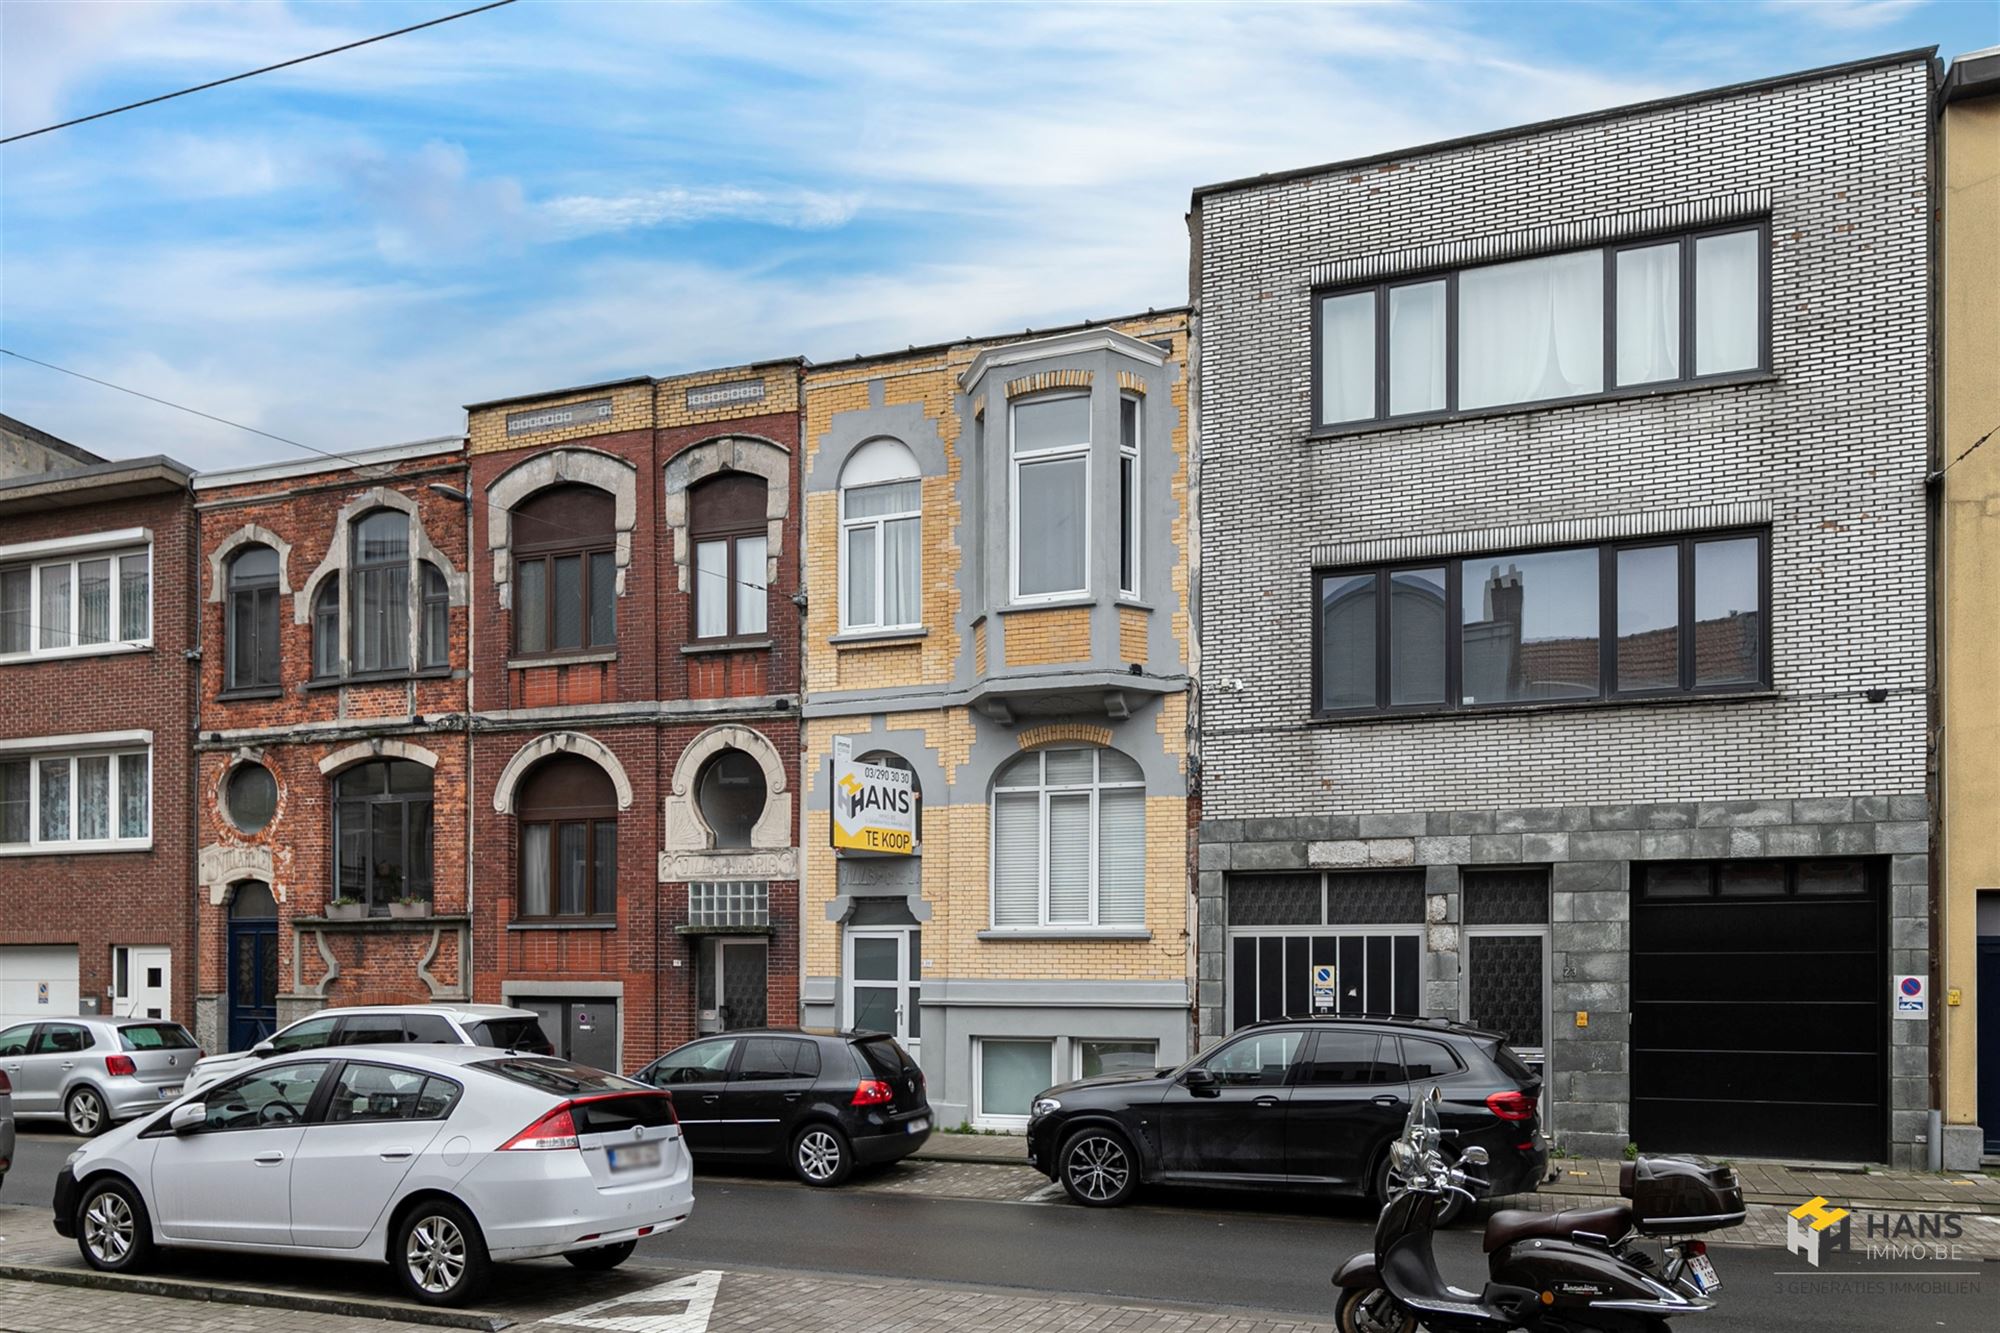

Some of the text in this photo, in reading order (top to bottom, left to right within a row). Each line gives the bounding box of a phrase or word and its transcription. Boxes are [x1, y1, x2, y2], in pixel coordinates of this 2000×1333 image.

[865, 767, 910, 785] 03/290 30 30
[850, 785, 910, 819] HANS
[865, 830, 911, 850] TE KOOP
[1564, 967, 1577, 977] 23
